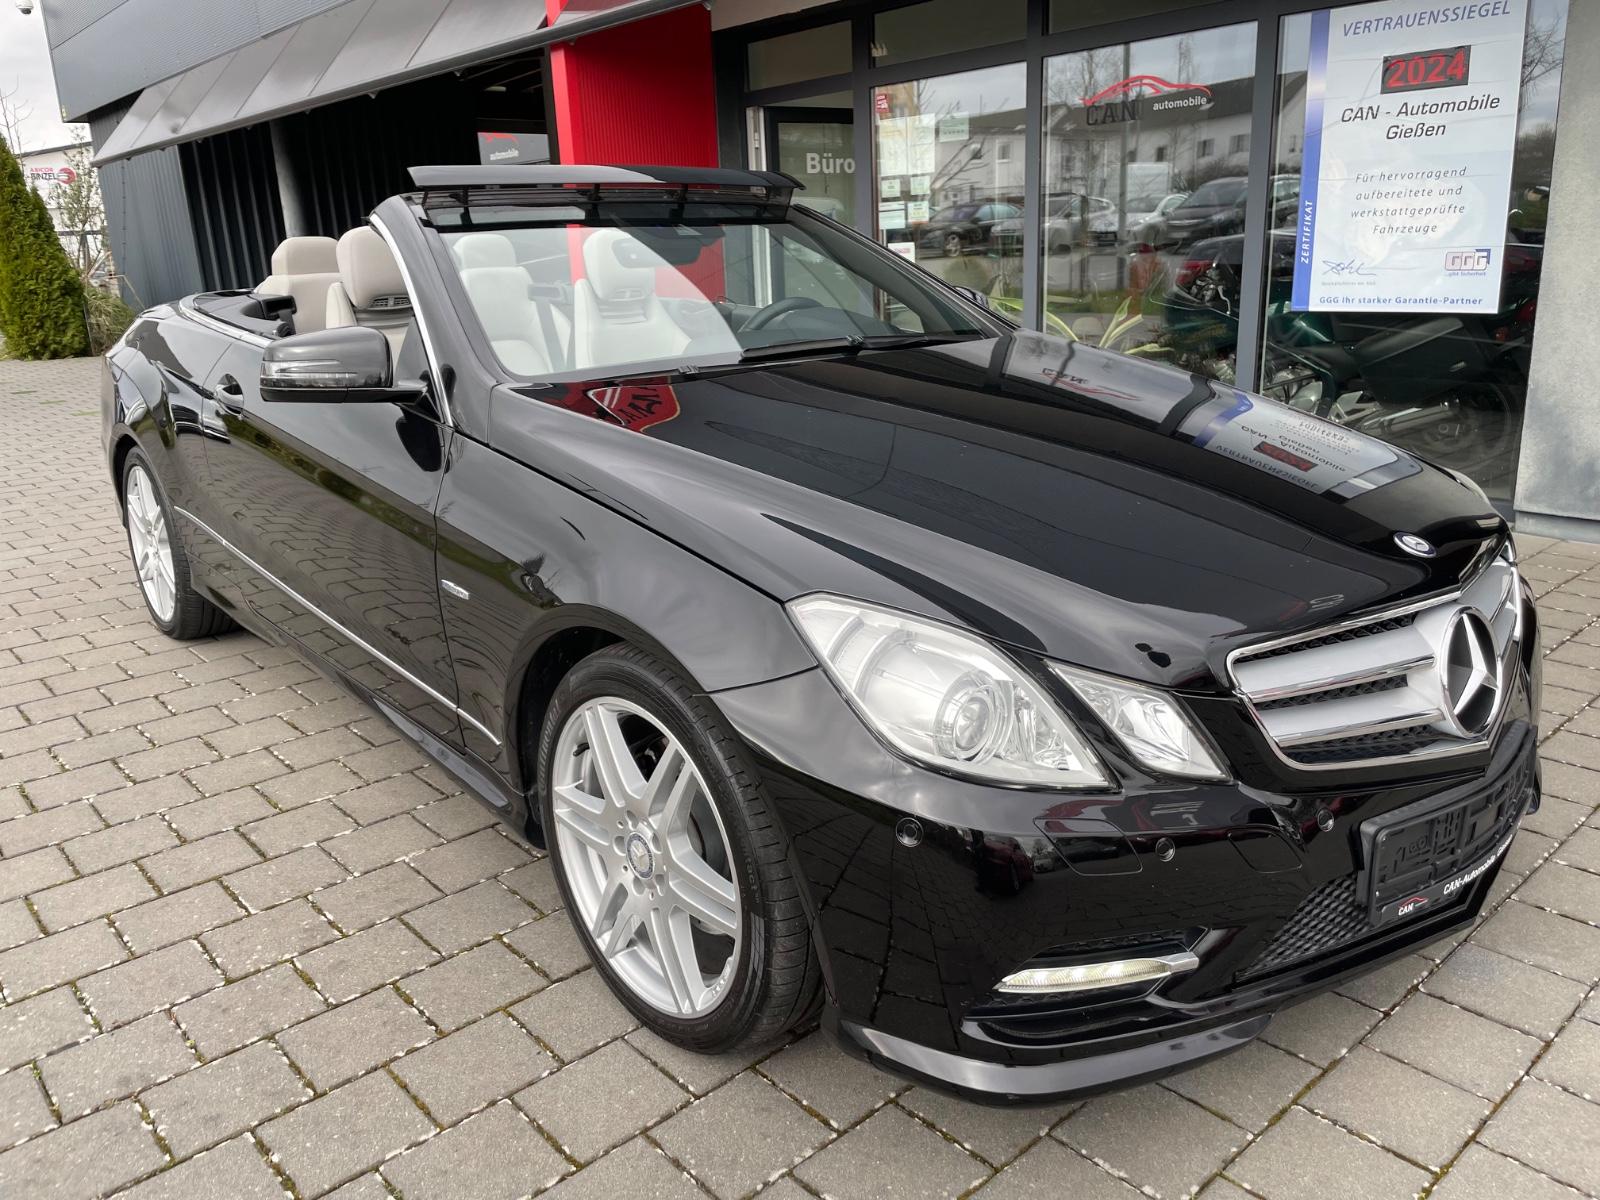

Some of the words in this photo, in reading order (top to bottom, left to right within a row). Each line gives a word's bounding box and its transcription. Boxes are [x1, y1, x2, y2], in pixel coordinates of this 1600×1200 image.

[1343, 1, 1511, 37] VERTRAUENSSIEGEL
[1387, 47, 1466, 88] 2024
[1153, 95, 1207, 111] automobile
[1341, 105, 1380, 123] CAN
[1396, 94, 1500, 118] Automobile
[1086, 100, 1137, 126] CAN
[1386, 122, 1446, 140] Gießen
[806, 152, 855, 173] Büro
[1355, 173, 1375, 183] Für
[1379, 166, 1467, 182] hervorragend
[1355, 188, 1433, 201] aufbereitete
[1438, 185, 1463, 196] und
[1351, 204, 1465, 219] werkstattgeprüfte
[1301, 200, 1313, 264] ZERTIFIKAT
[1372, 223, 1438, 236] Fahrzeuge
[1319, 296, 1339, 304] GGG
[1357, 296, 1392, 304] starker
[1395, 296, 1483, 305] Garantie-Partner
[1398, 902, 1415, 916] CAN
